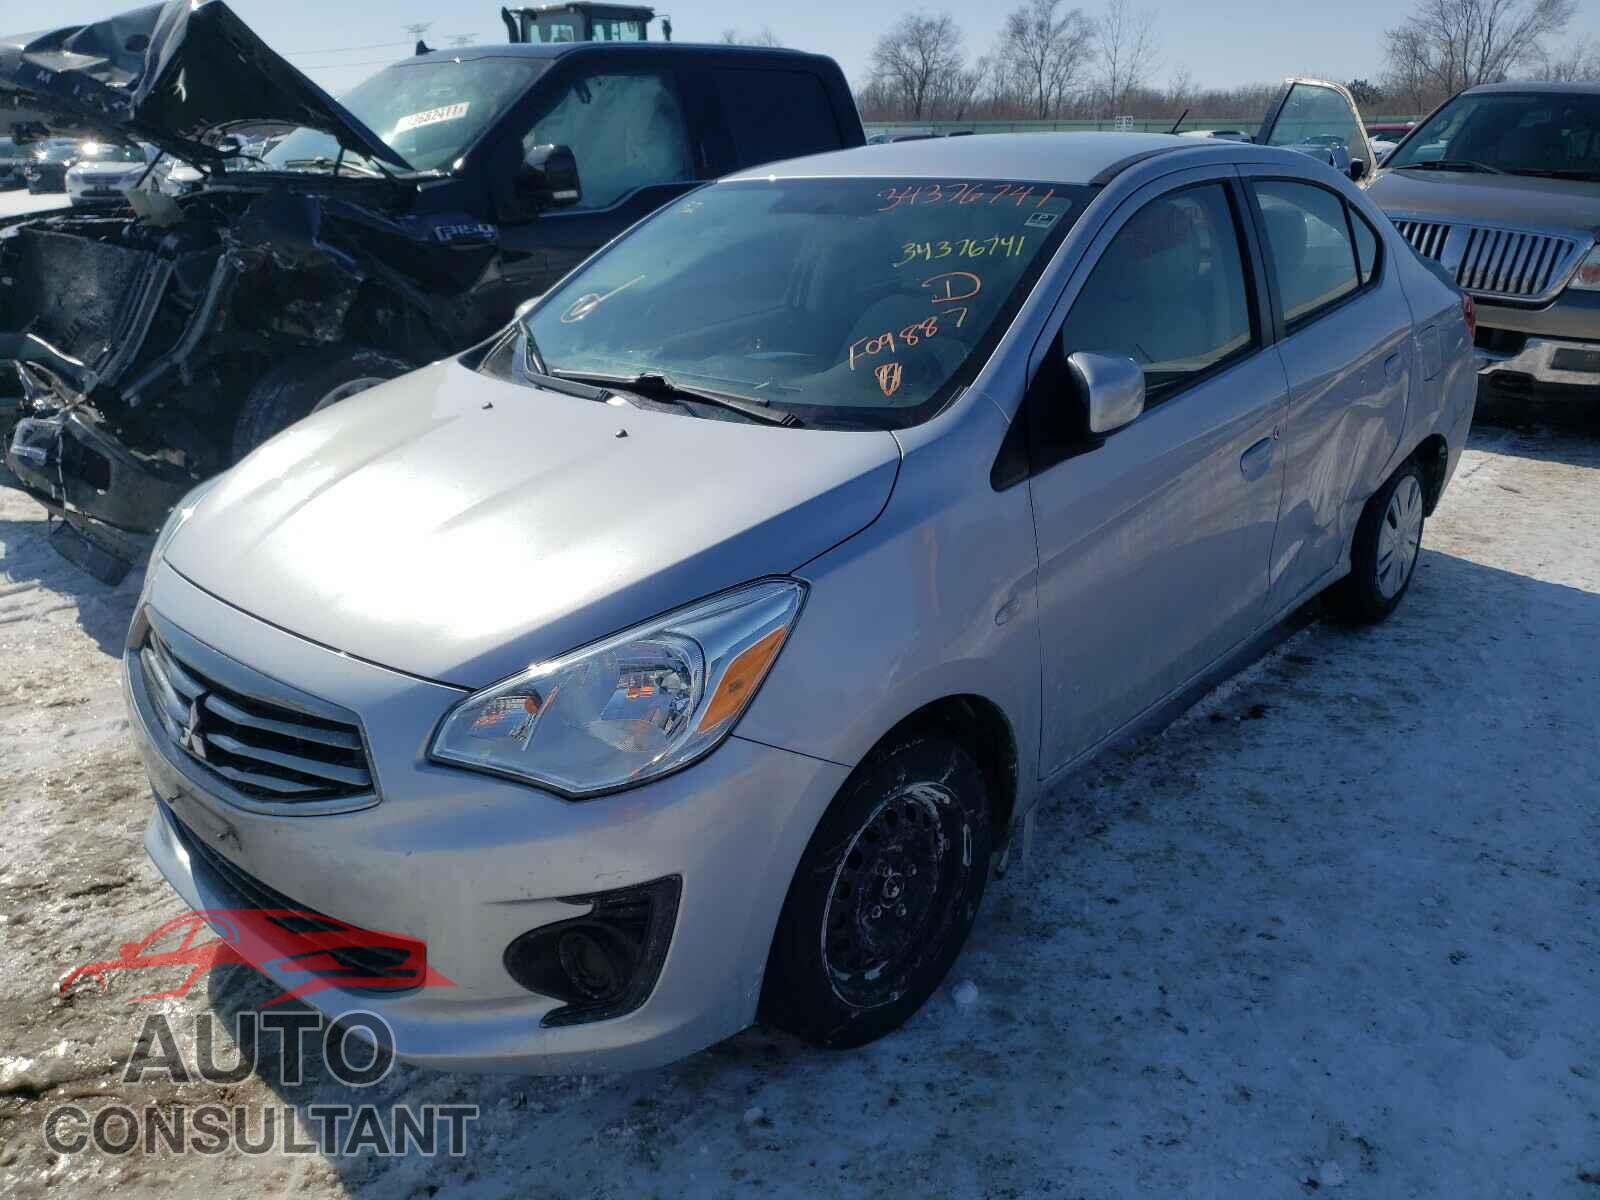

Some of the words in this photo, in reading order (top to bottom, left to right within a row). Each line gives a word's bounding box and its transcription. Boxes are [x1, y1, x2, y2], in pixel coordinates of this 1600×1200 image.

[877, 183, 1055, 212] 34376741
[892, 235, 1026, 269] 34376741
[921, 271, 982, 303] D
